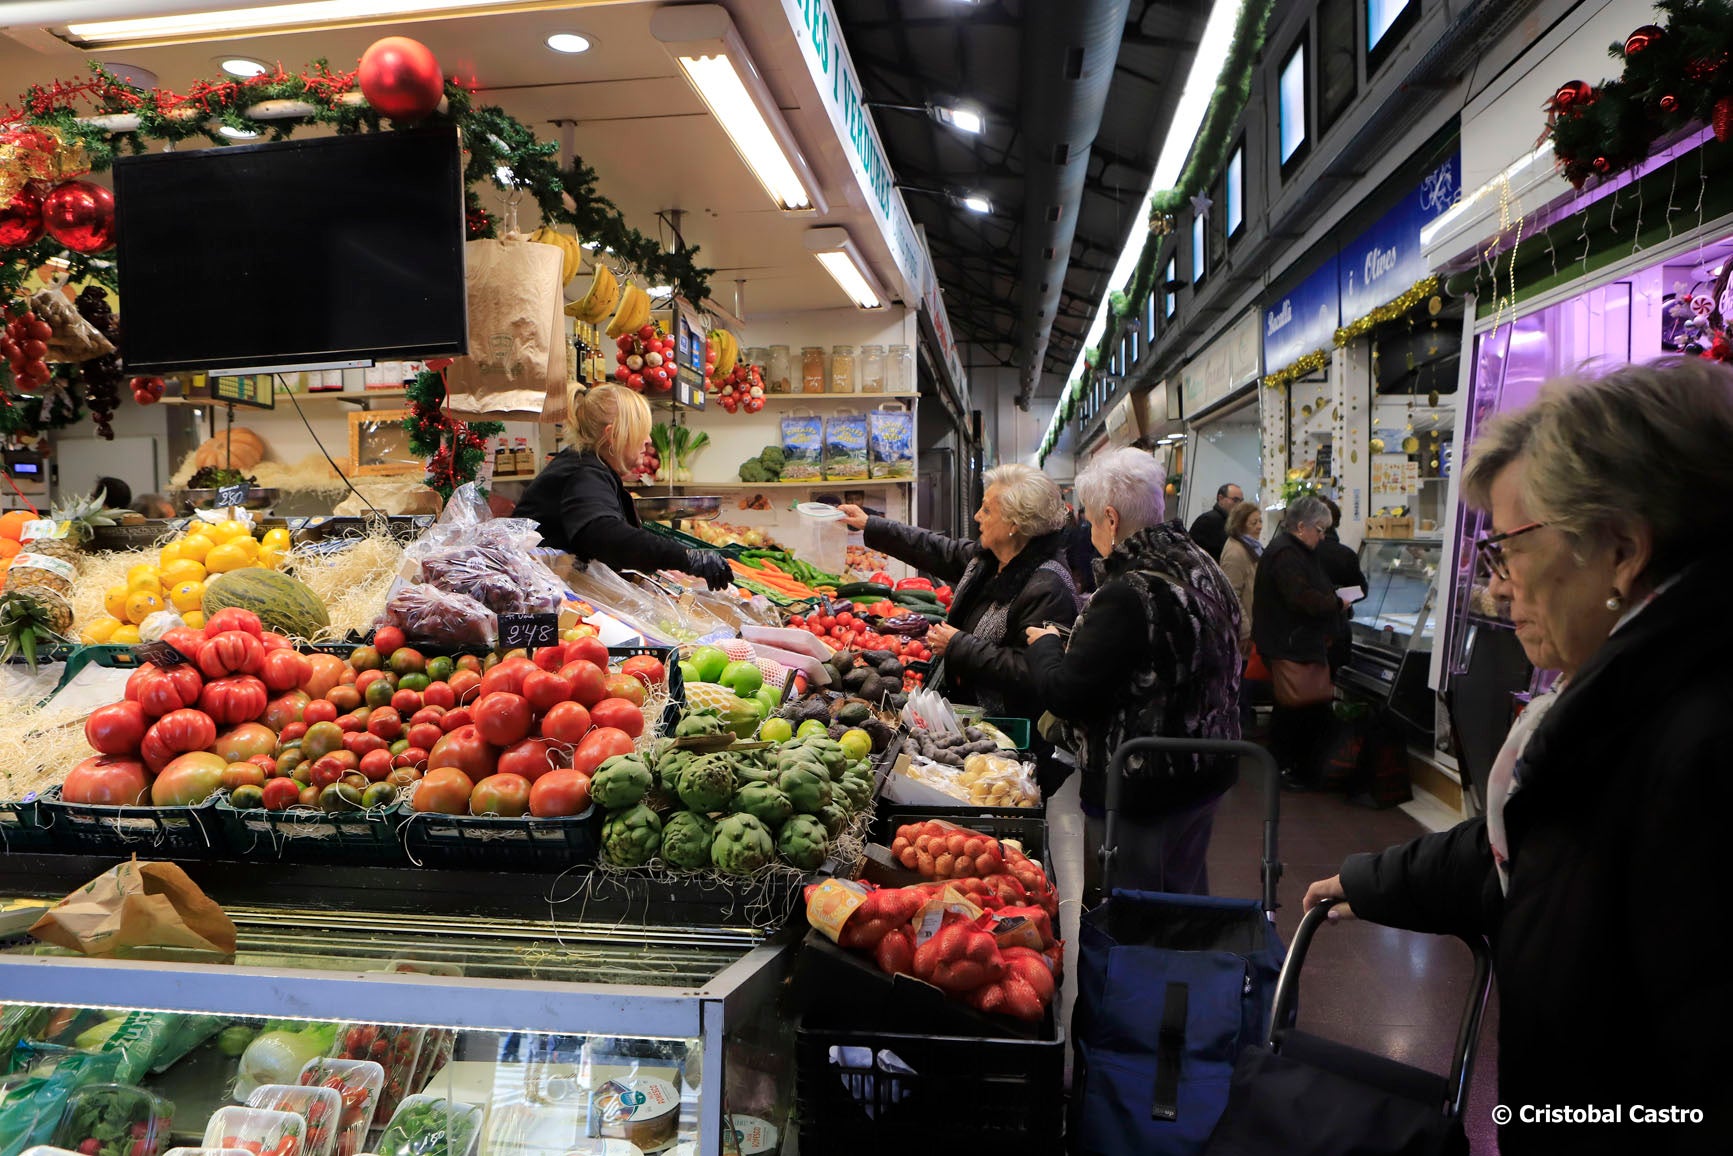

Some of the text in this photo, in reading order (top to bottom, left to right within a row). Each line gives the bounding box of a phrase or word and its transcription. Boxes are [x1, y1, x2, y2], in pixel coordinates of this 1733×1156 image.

[843, 67, 891, 221] VERDURES
[1348, 270, 1353, 297] i
[1364, 246, 1397, 286] Olives
[507, 623, 554, 646] 2'48
